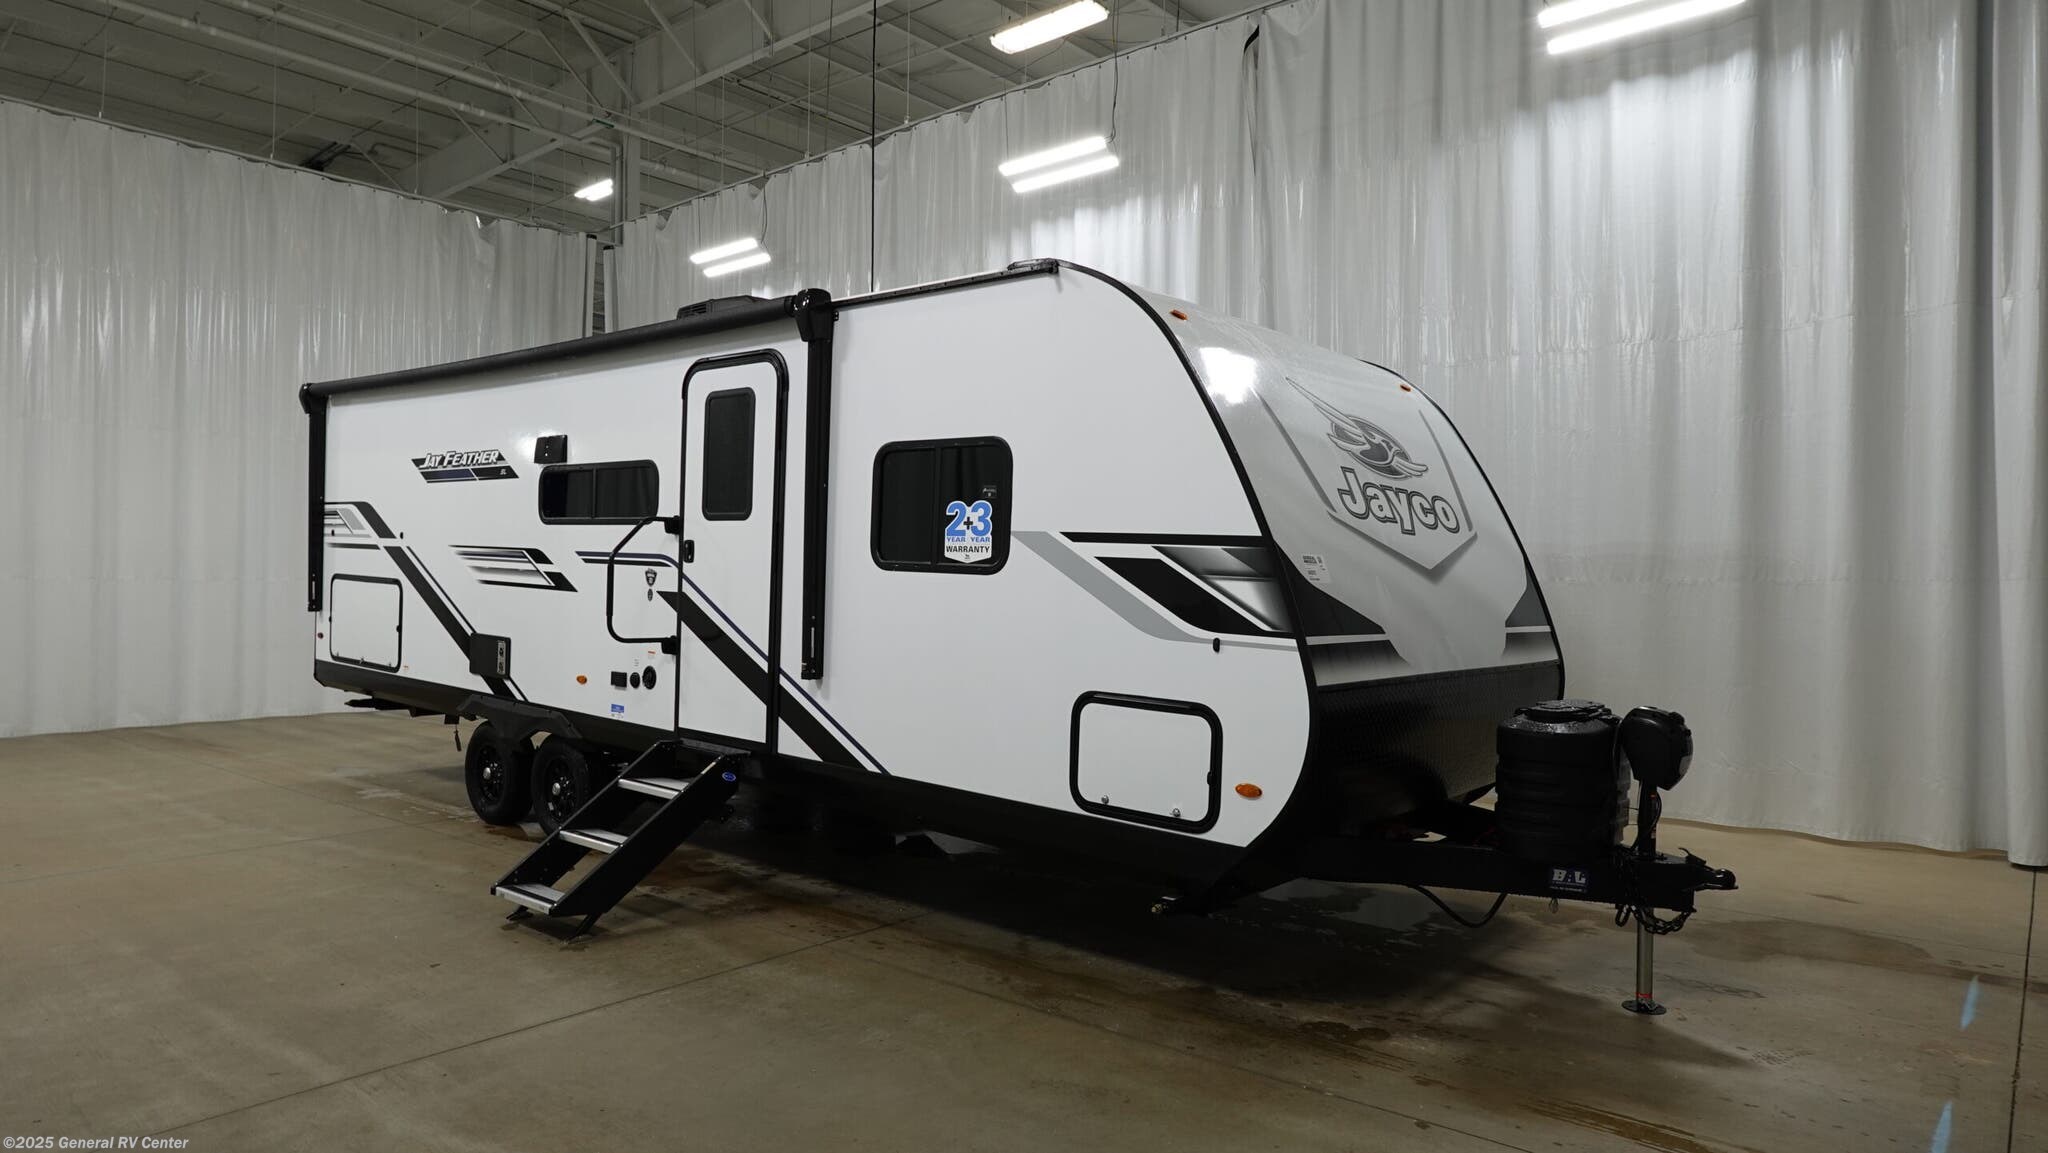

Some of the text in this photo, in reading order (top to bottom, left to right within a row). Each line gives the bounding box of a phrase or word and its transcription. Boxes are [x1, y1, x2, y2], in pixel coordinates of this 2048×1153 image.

[419, 449, 499, 469] JAY FEATHER
[1337, 466, 1460, 535] Jayco
[946, 545, 990, 553] WARRANTY
